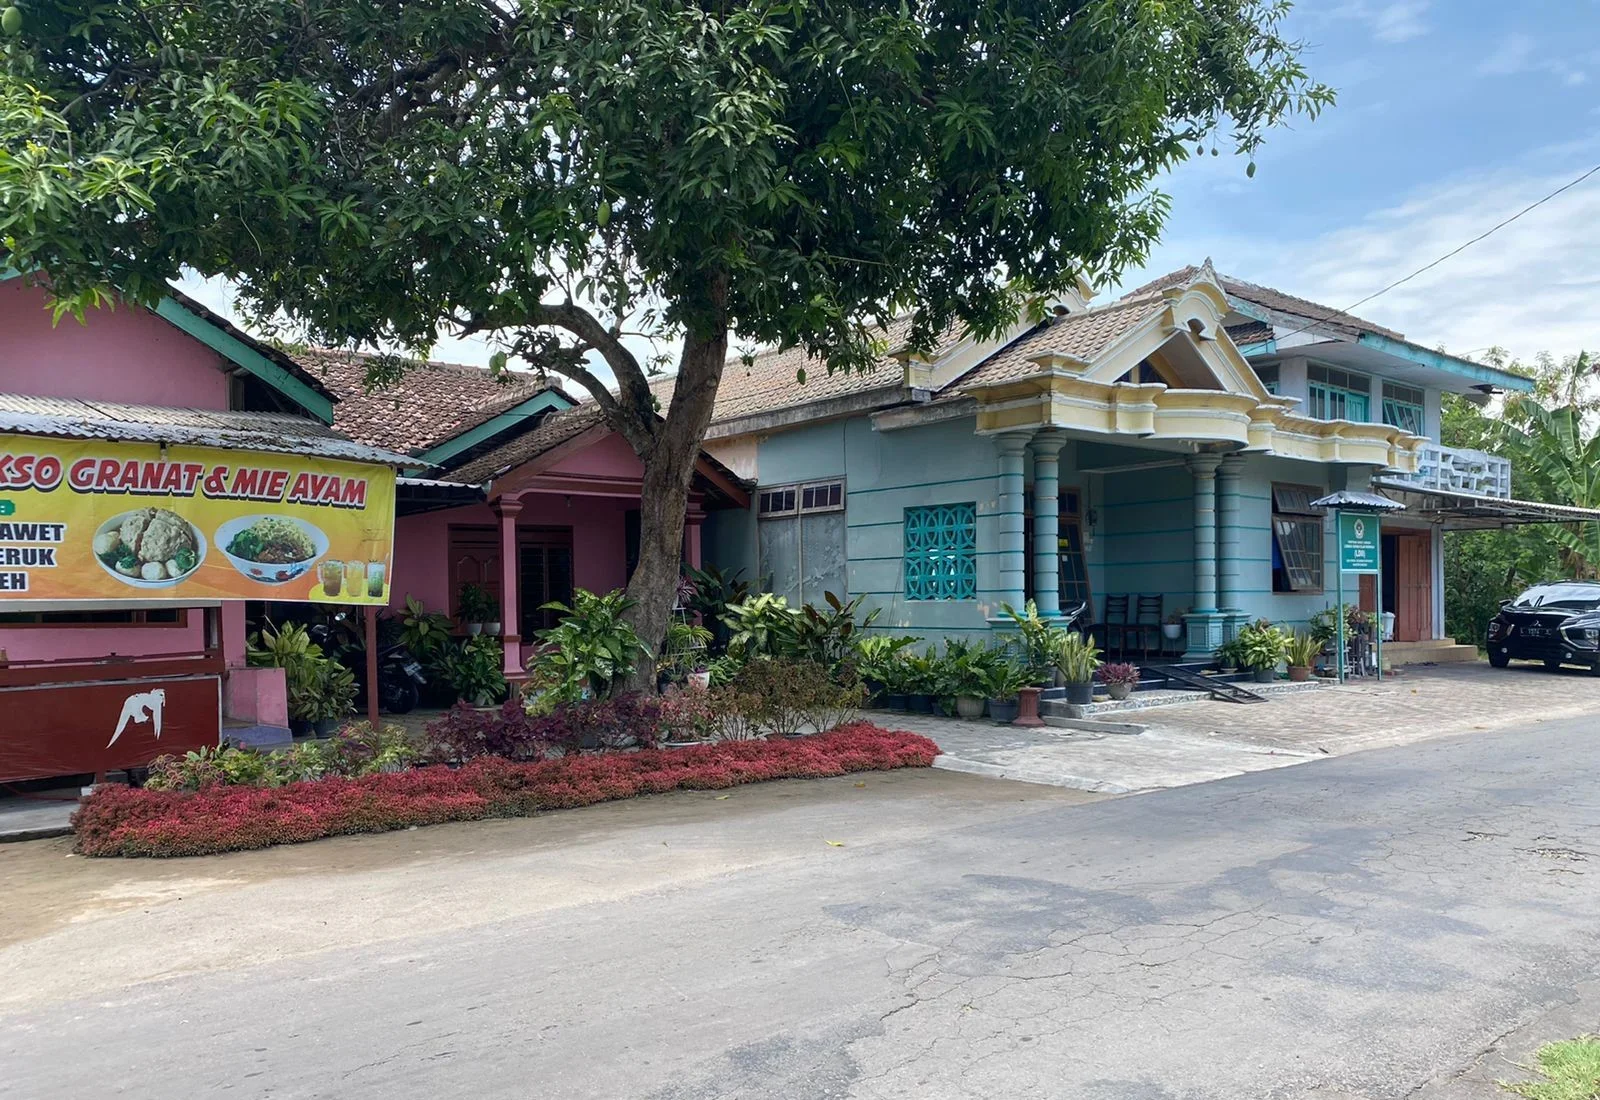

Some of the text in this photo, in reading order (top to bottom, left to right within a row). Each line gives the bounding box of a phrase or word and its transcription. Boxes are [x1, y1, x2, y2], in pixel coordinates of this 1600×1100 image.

[70, 458, 202, 491] GRANAT
[204, 466, 228, 493] &
[231, 468, 288, 497] MIE
[290, 473, 366, 504] AYAM
[0, 523, 64, 541] AWET
[0, 572, 26, 590] EH
